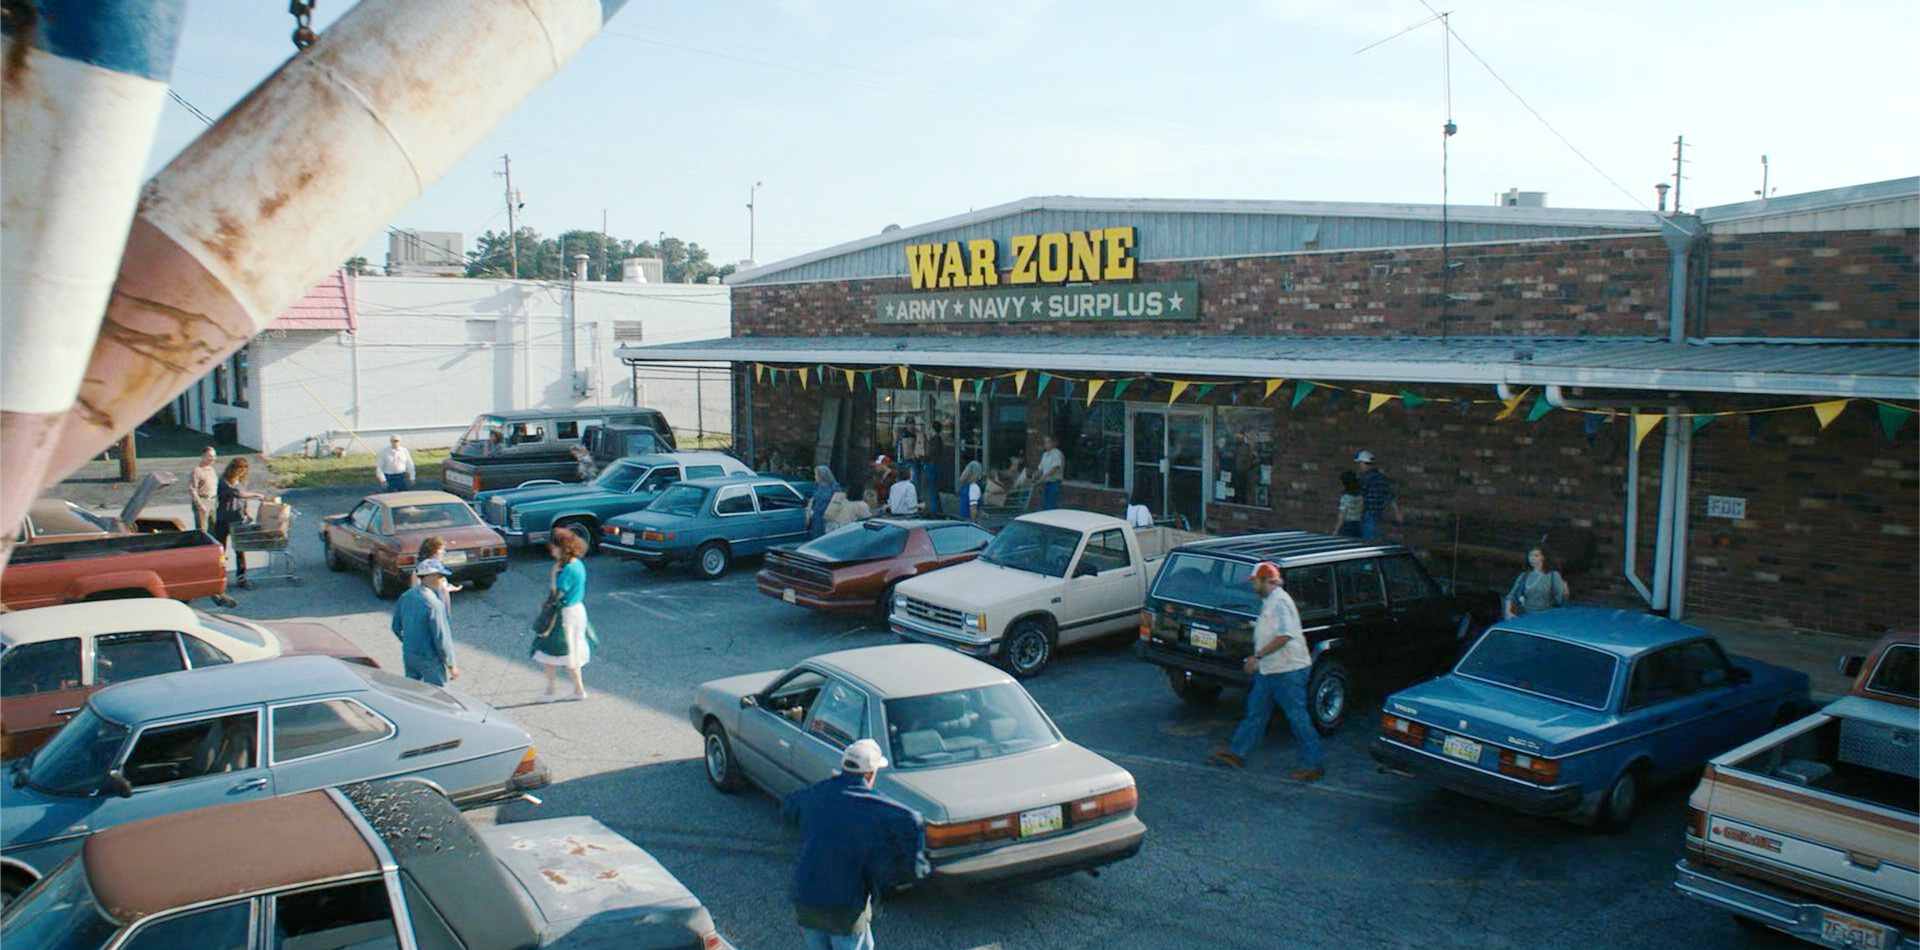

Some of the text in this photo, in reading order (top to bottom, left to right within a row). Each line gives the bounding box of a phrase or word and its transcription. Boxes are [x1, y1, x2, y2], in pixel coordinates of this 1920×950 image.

[906, 226, 1137, 290] WAR ZONE
[897, 291, 1164, 321] ARMY NAVY SURPLUS
[1713, 499, 1741, 516] FDC
